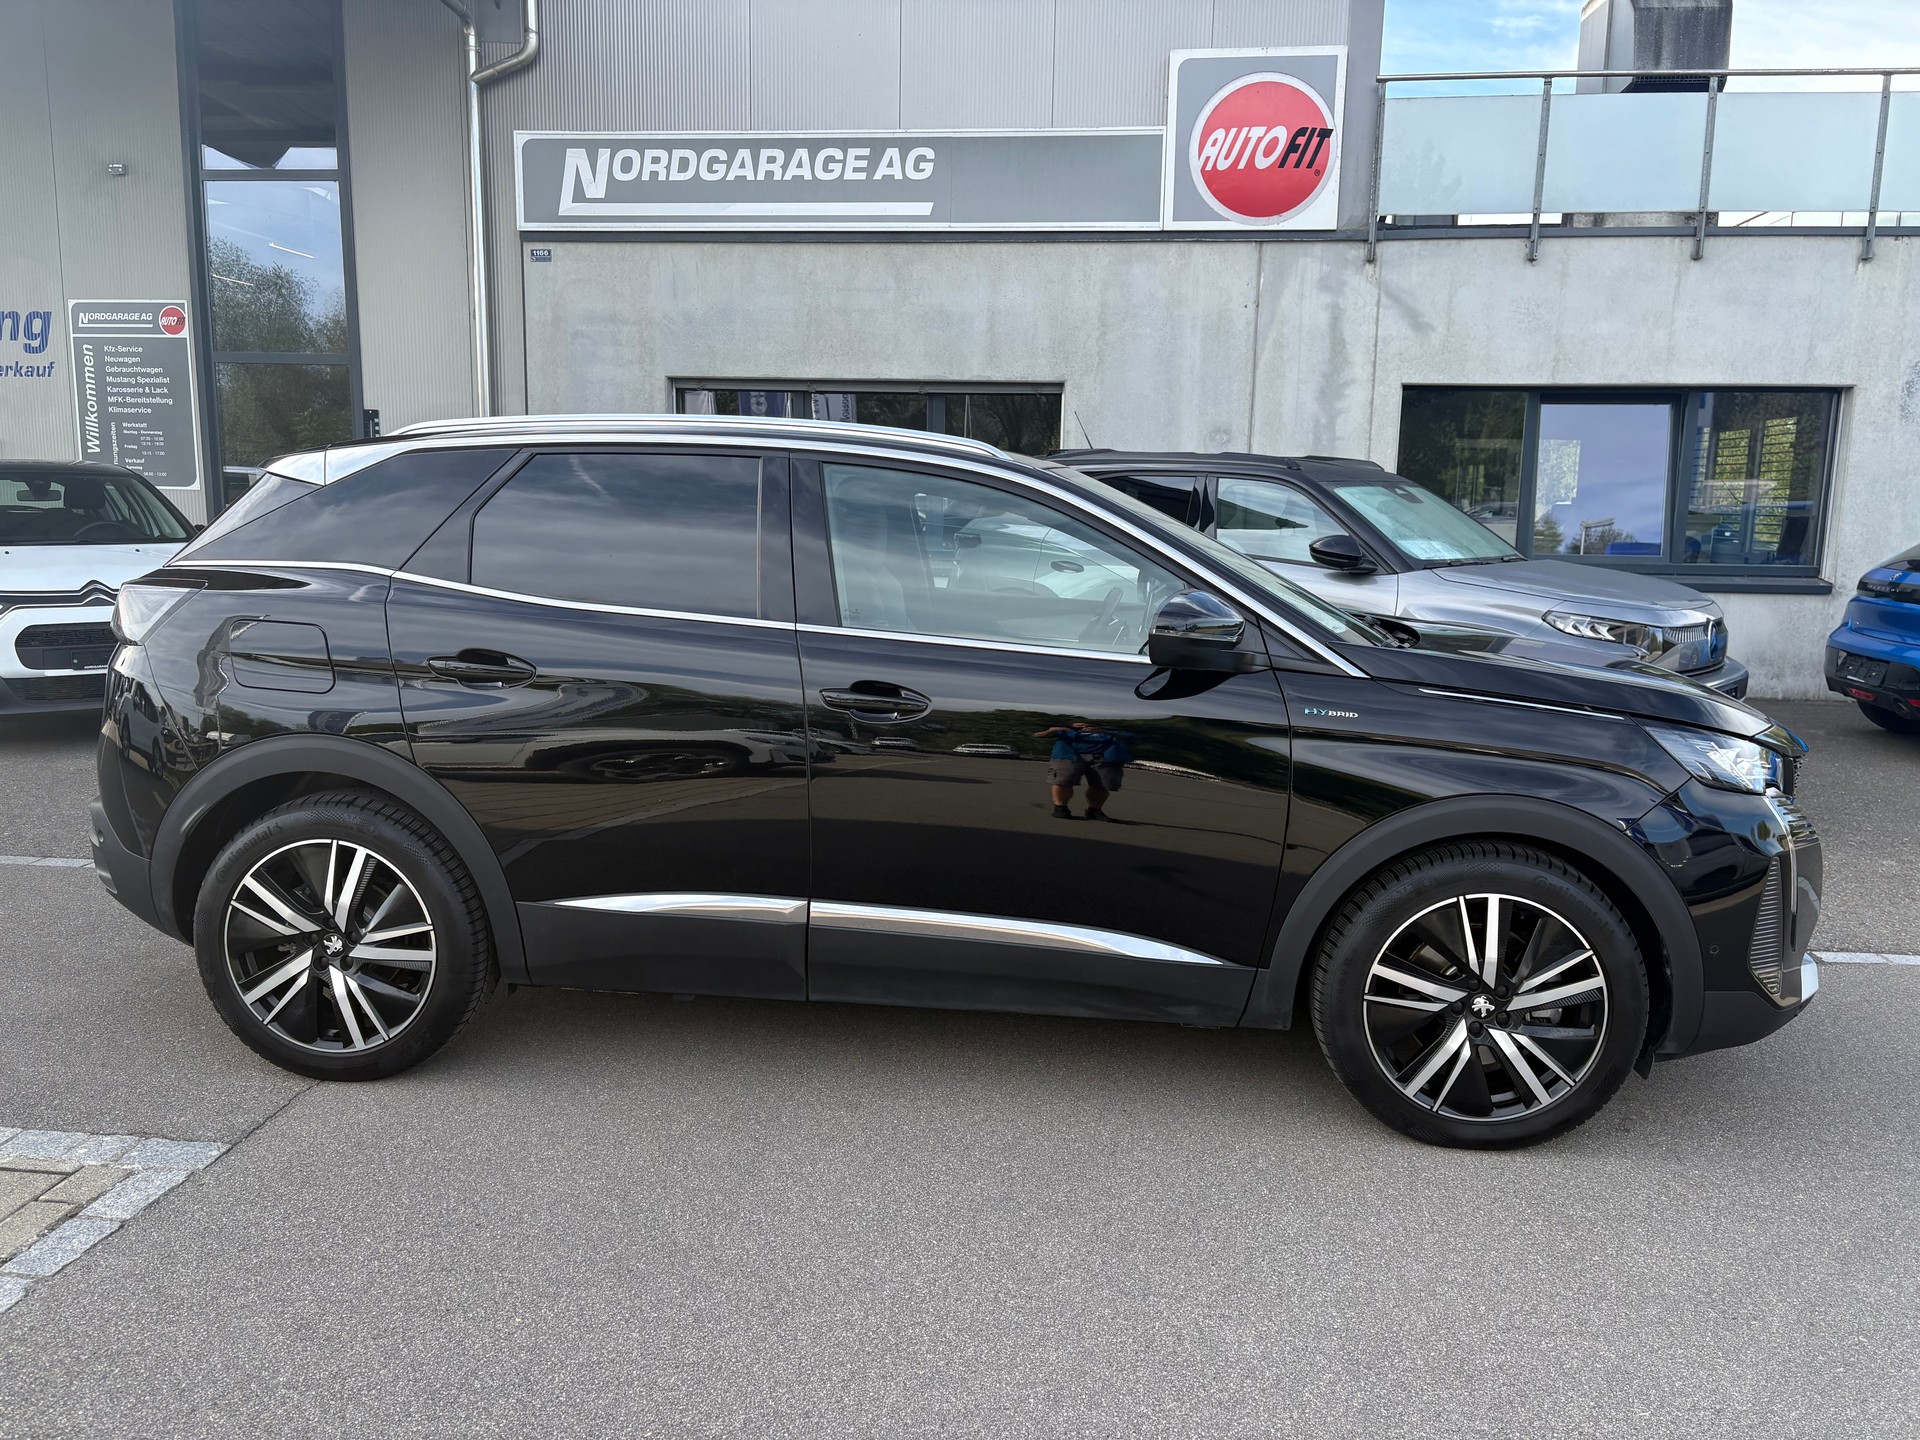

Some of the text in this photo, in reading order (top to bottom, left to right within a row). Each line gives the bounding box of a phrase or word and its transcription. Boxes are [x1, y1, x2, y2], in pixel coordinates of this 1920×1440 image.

[1199, 125, 1334, 171] AUTOFIT
[559, 147, 936, 199] NORDGARAGE AG
[79, 313, 140, 323] NORDGARAGE
[0, 311, 52, 354] ng
[104, 345, 143, 353] Kfz-Service
[105, 355, 141, 364] Neuwagen
[105, 366, 163, 374] Gebrauchtwagen
[106, 376, 170, 384] Mustang Spezialist
[151, 386, 169, 394] Lack
[83, 344, 100, 453] Willkommen
[107, 396, 173, 405] MFK-Bereitstellung
[108, 406, 152, 414] Klimaservice
[1304, 707, 1359, 718] HYBRID
